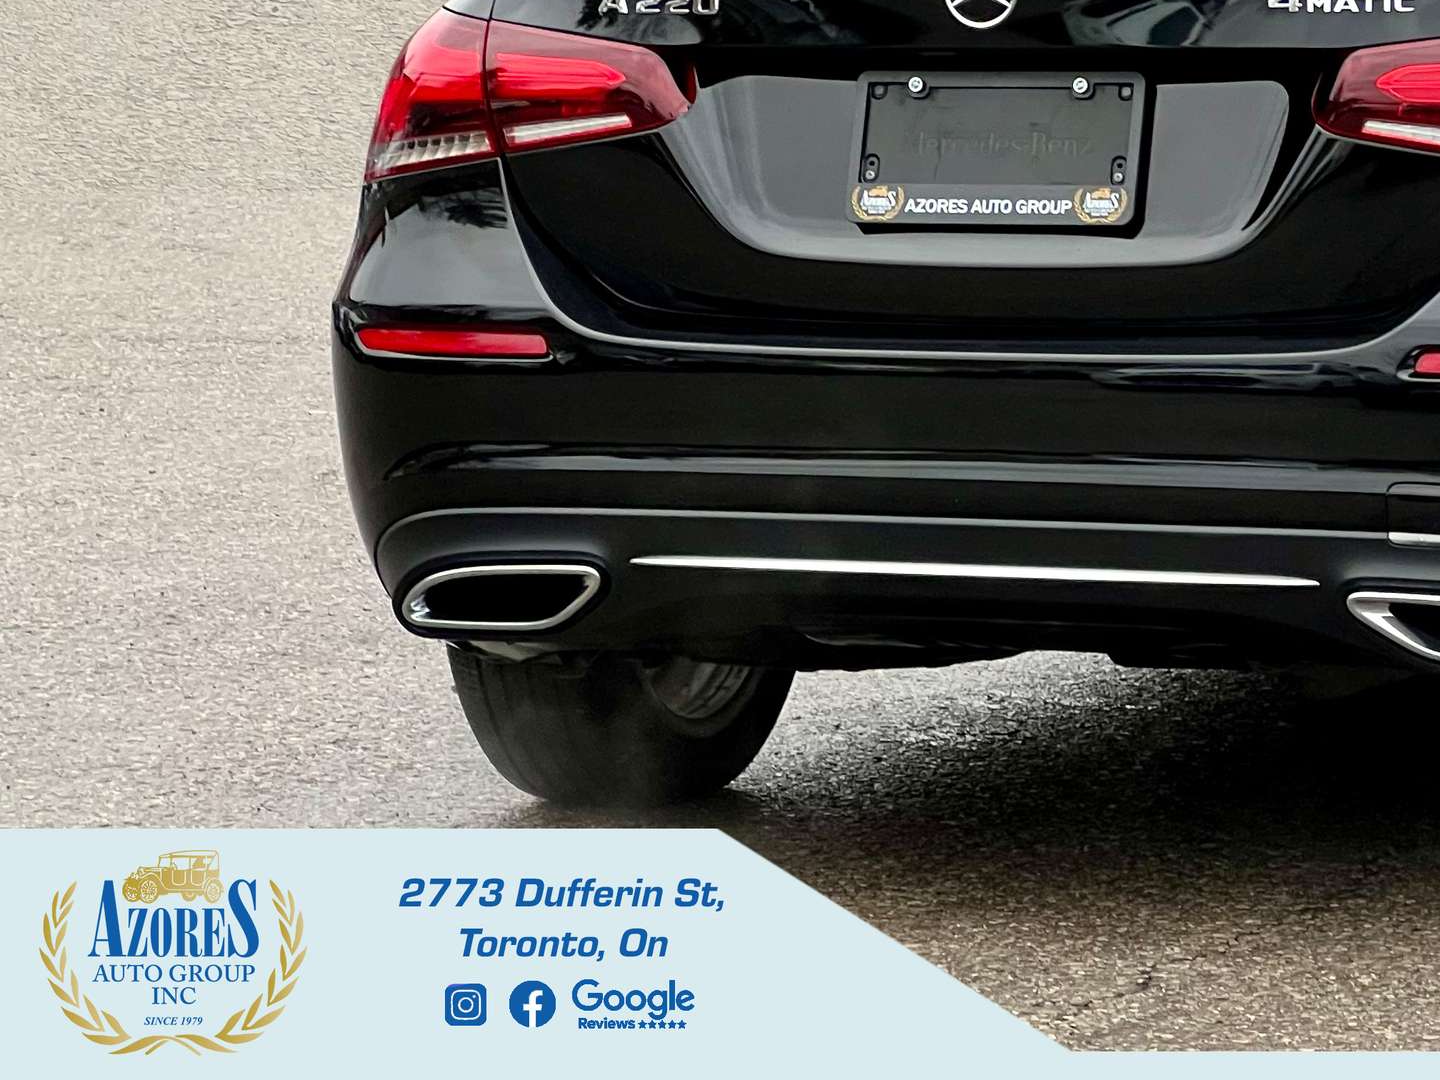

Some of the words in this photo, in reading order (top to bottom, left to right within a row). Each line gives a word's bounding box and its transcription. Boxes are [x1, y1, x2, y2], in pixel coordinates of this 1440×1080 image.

[904, 198, 968, 214] AZORES
[970, 199, 1012, 215] AUTO
[1015, 199, 1072, 215] GROUP
